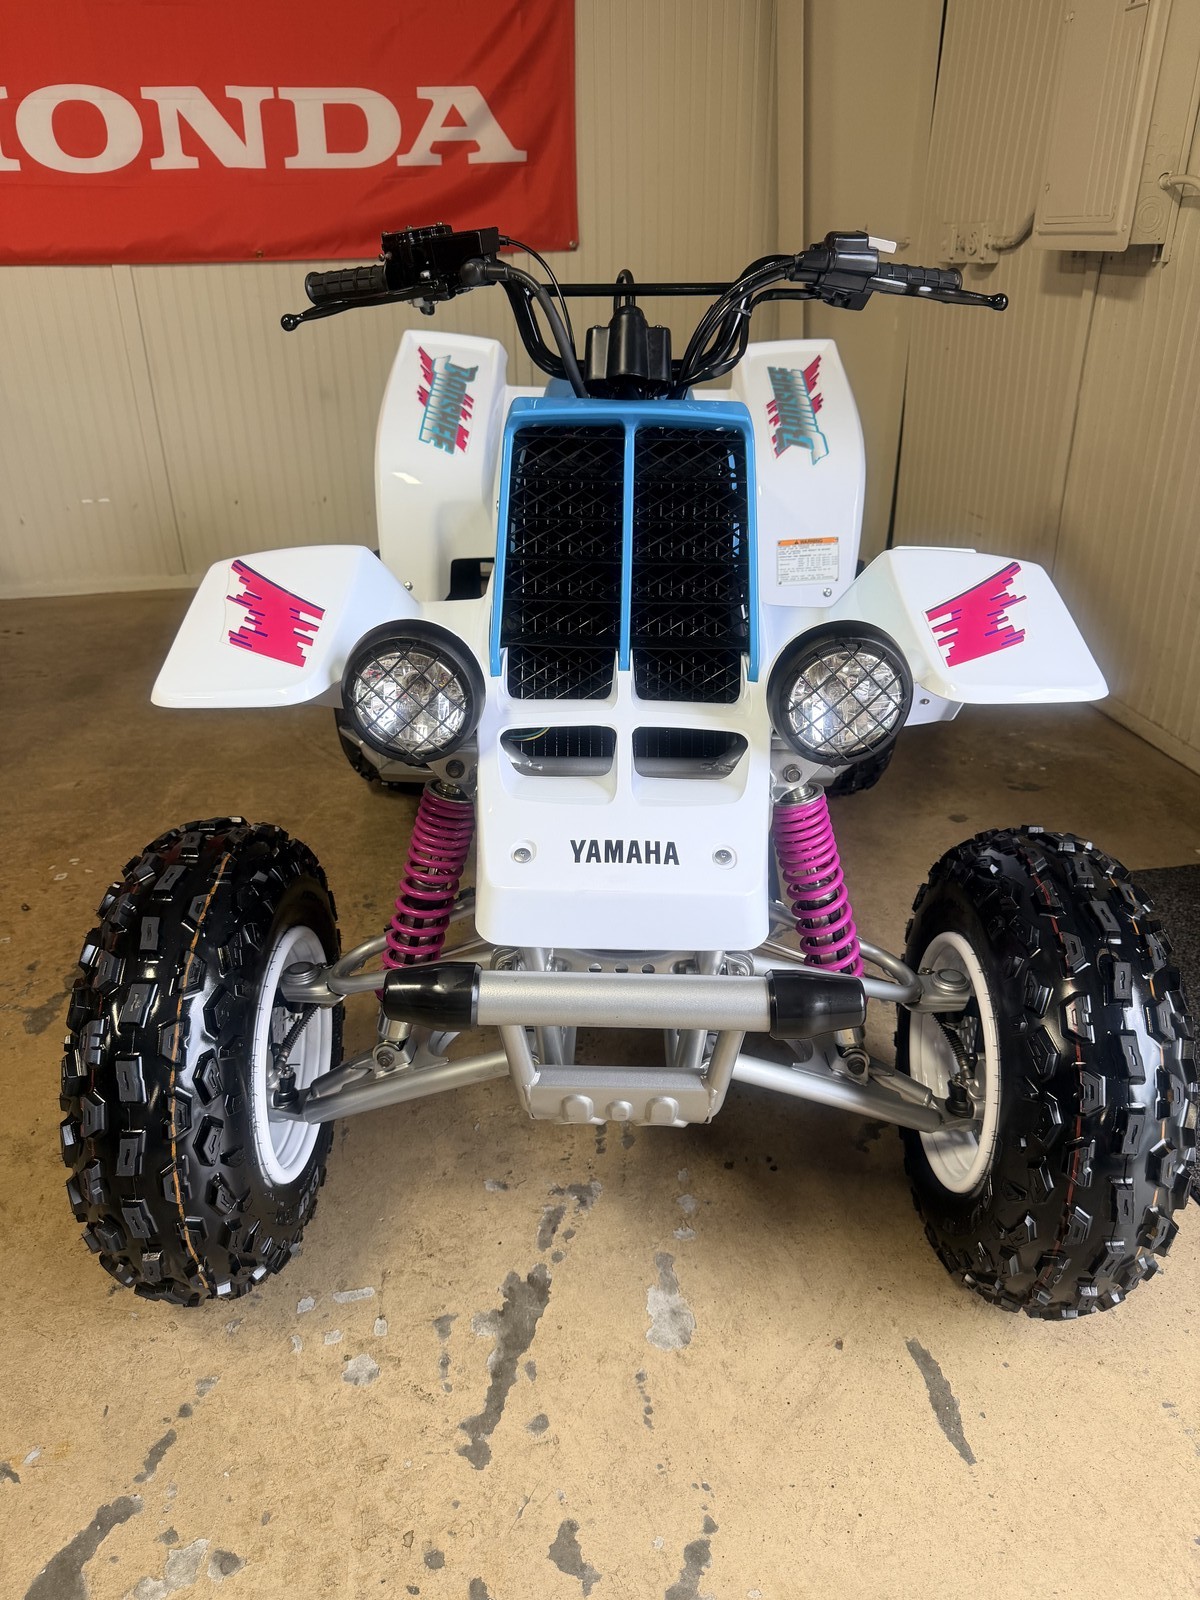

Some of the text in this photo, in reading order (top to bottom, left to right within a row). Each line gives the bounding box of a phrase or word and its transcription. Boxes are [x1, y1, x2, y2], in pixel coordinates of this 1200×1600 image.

[0, 83, 527, 174] ONDA
[418, 354, 480, 456] BANSHEE
[766, 366, 830, 466] BANSHEE
[570, 839, 680, 866] YAMAHA
